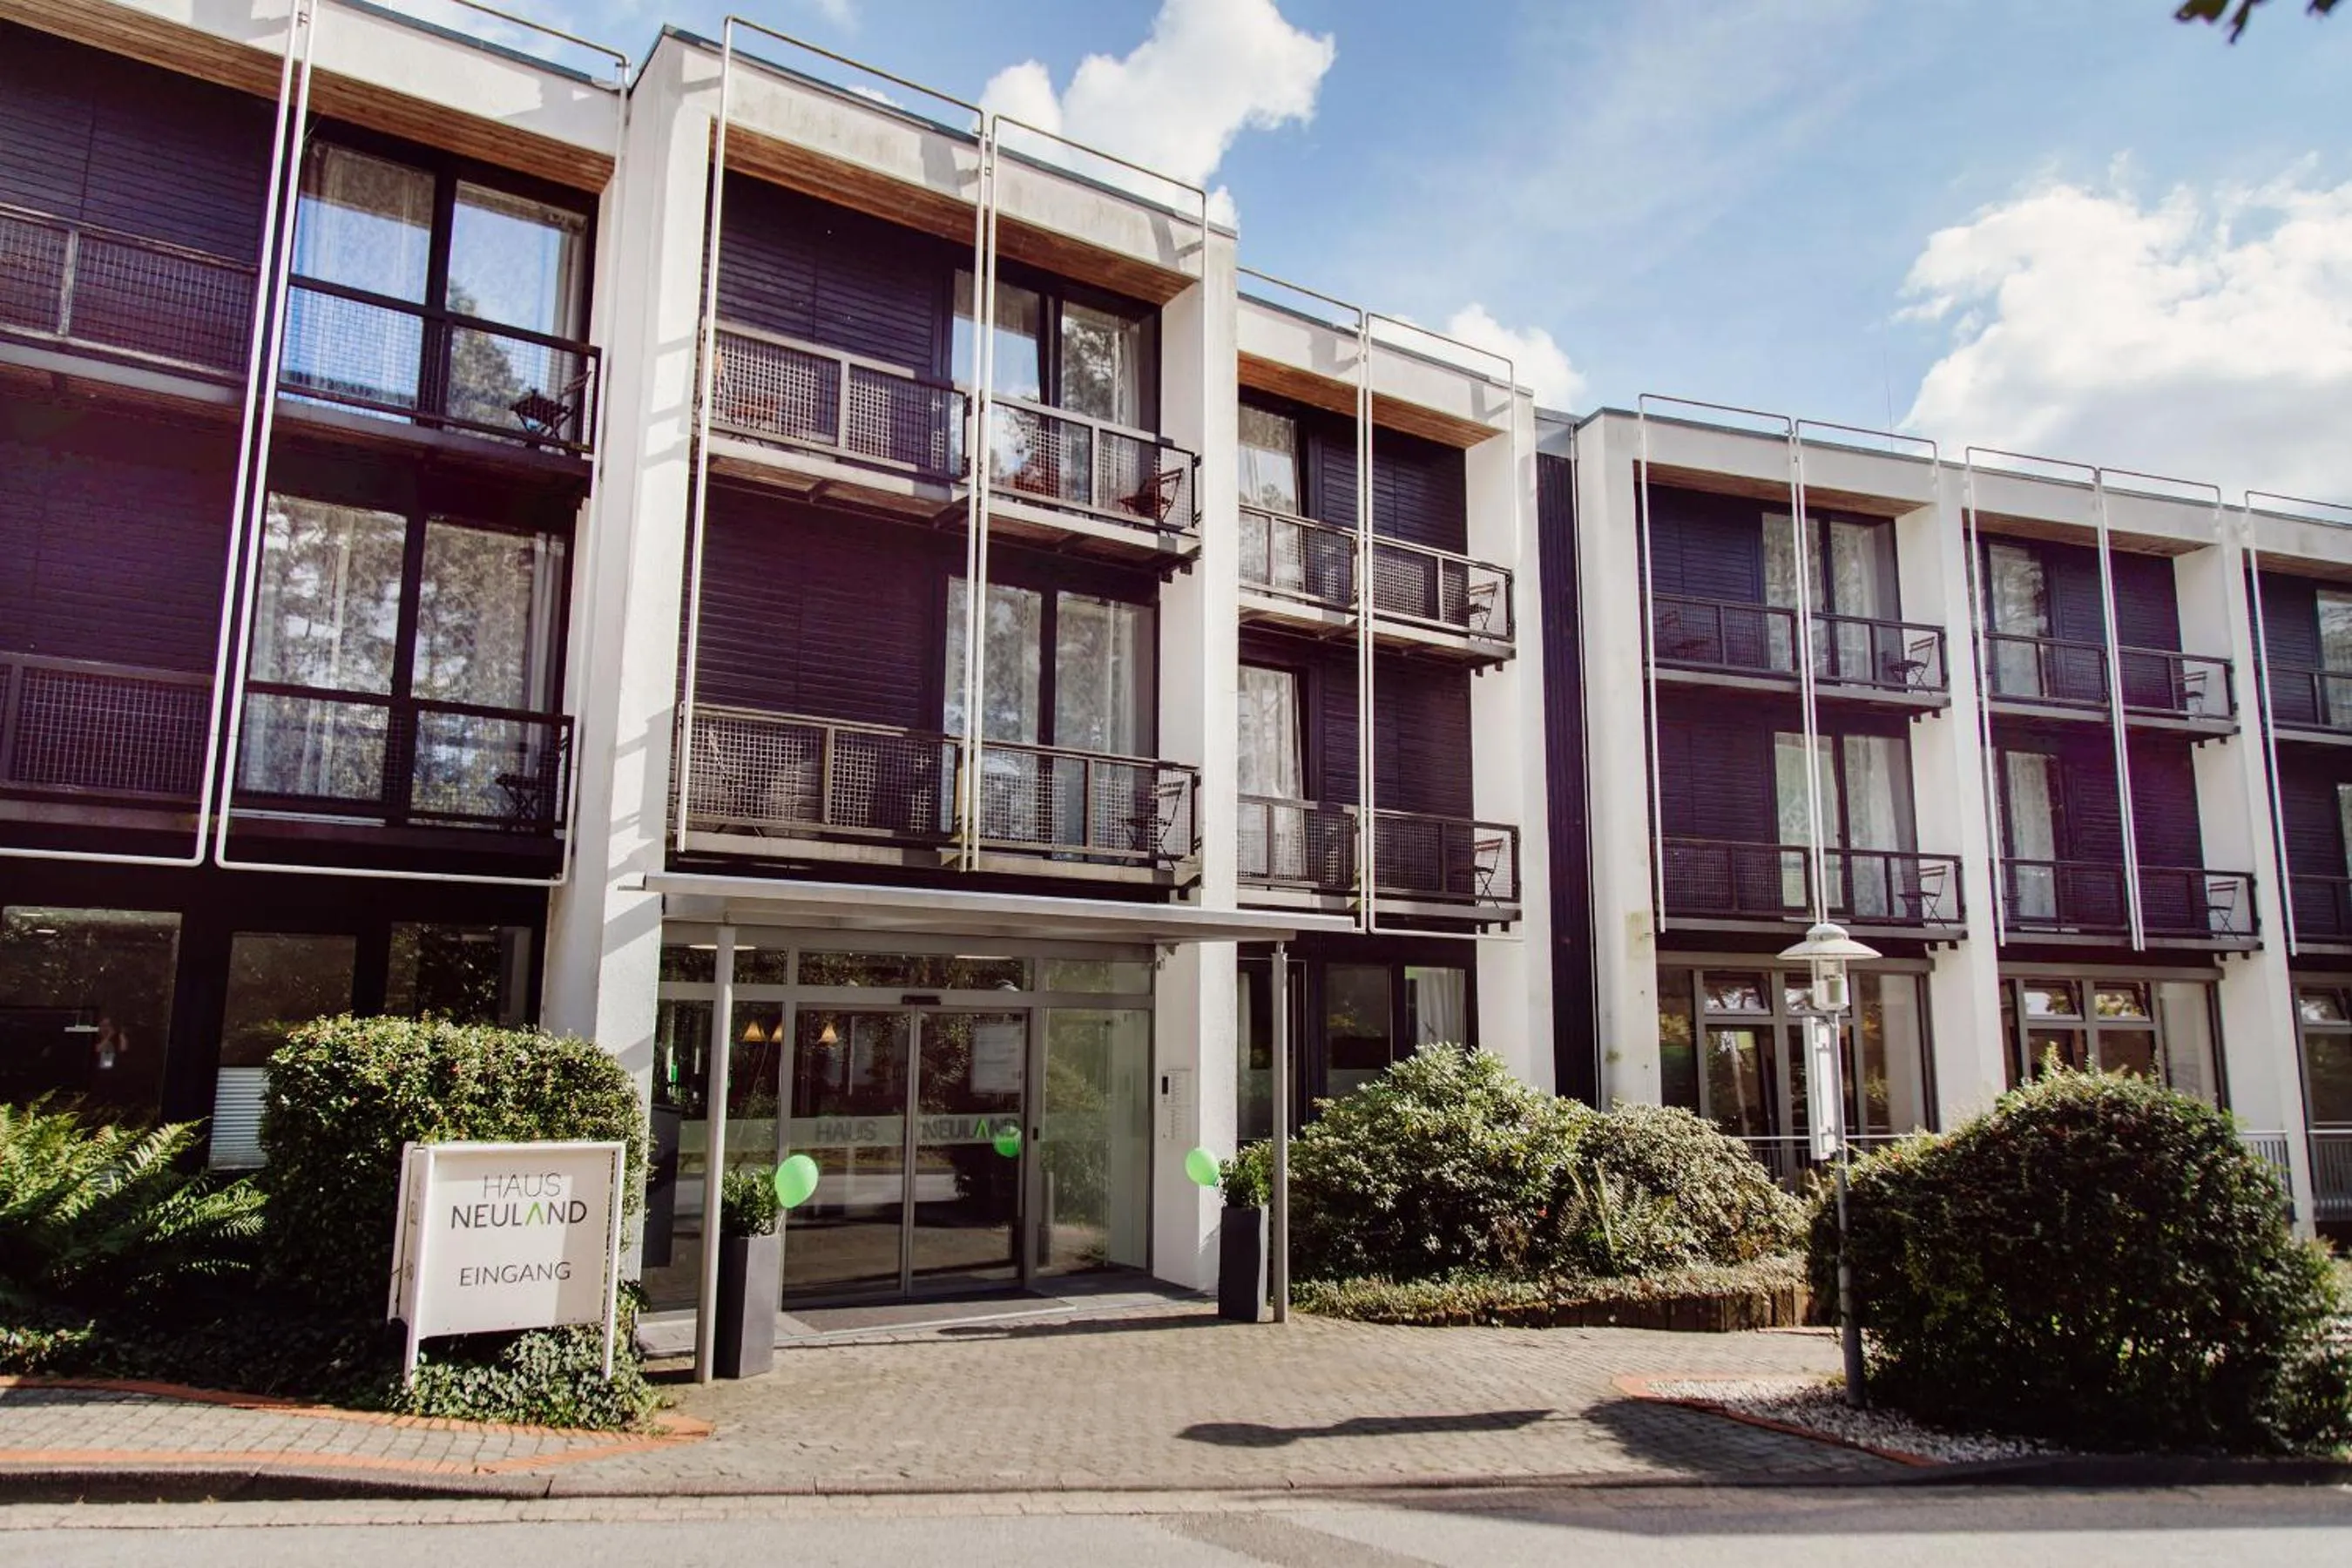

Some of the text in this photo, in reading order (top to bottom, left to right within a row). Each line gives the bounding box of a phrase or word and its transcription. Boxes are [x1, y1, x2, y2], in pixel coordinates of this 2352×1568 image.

[814, 1118, 877, 1142] HAUS
[483, 1173, 562, 1199] HAUS
[451, 1200, 587, 1229] NEULAND
[460, 1261, 571, 1287] EINGANG
